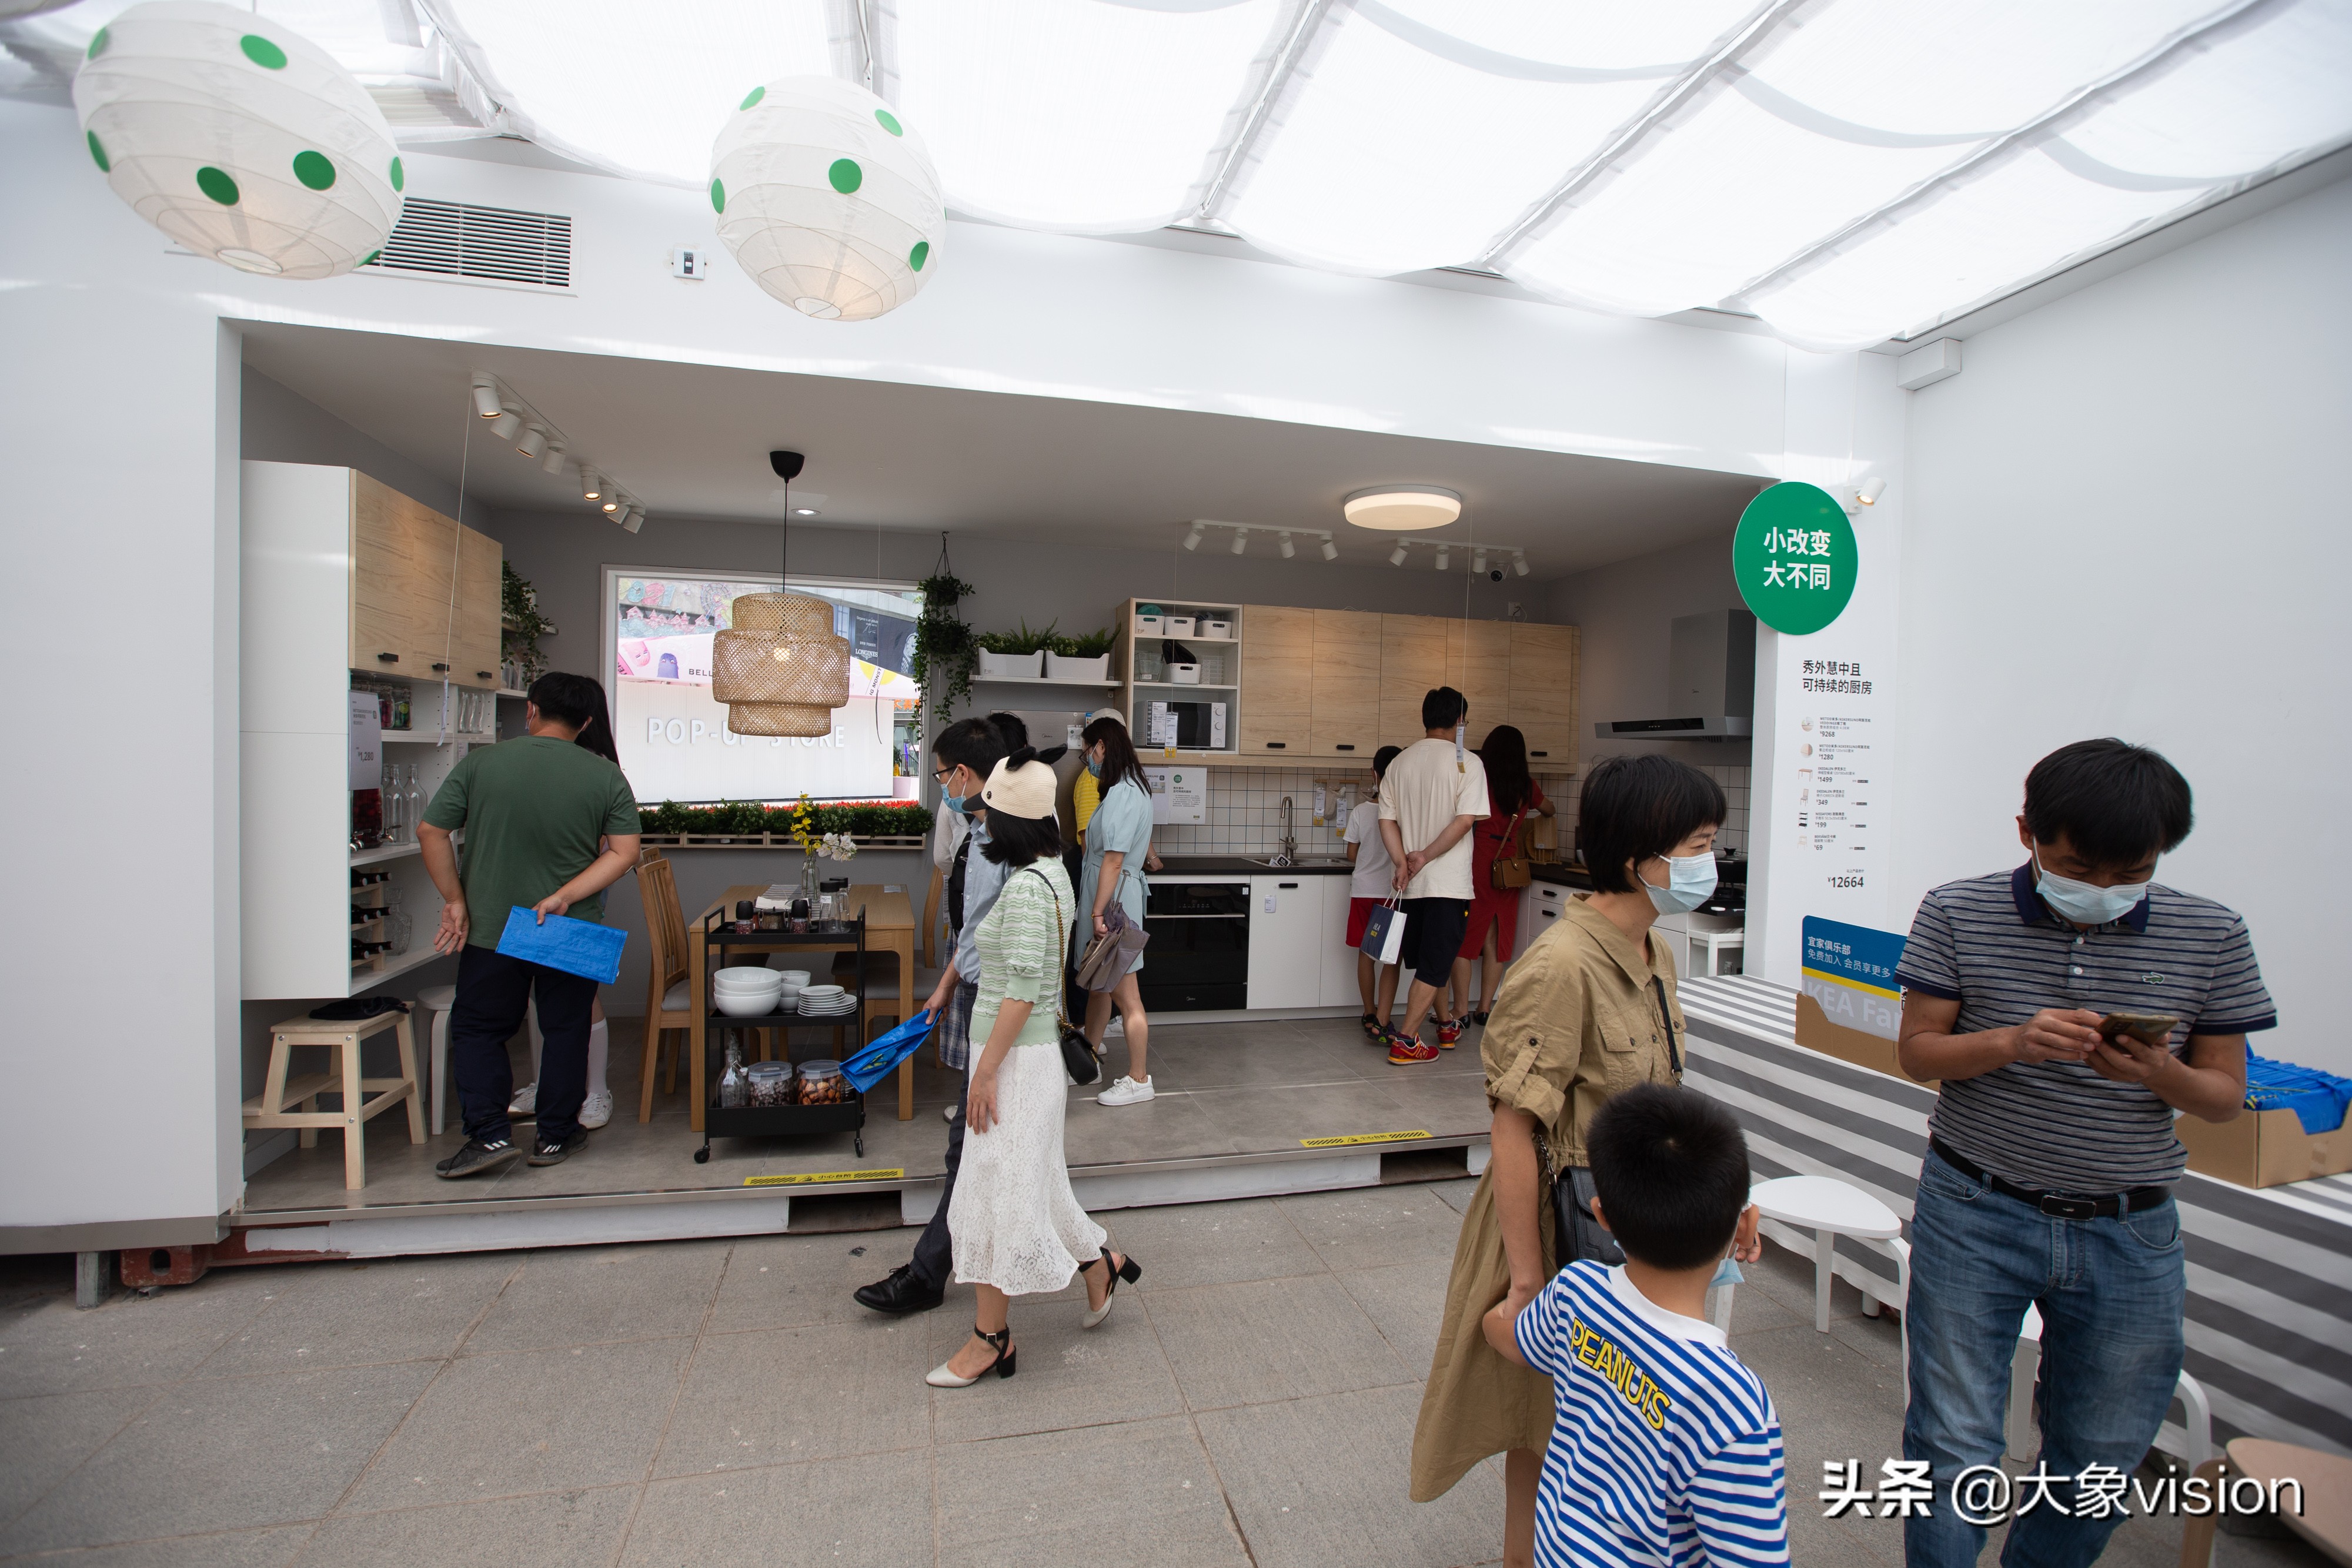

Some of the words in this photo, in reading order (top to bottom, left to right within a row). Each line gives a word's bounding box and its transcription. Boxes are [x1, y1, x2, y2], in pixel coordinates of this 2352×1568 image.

[1763, 527, 1831, 557] 小改变
[1763, 560, 1830, 590] 大不同
[855, 648, 878, 657] LONGINES
[1802, 660, 1861, 676] 秀外慧中且
[1802, 678, 1872, 694] 可持续的厨房
[647, 718, 748, 745] POP-U
[358, 751, 374, 762] ¥1,280
[1828, 877, 1864, 888] ¥12664
[1808, 936, 1851, 955] 宜家俱乐部
[1808, 948, 1842, 967] 免费加入
[1844, 958, 1890, 978] 会员享更多
[1571, 1317, 1672, 1430] PEANUTS
